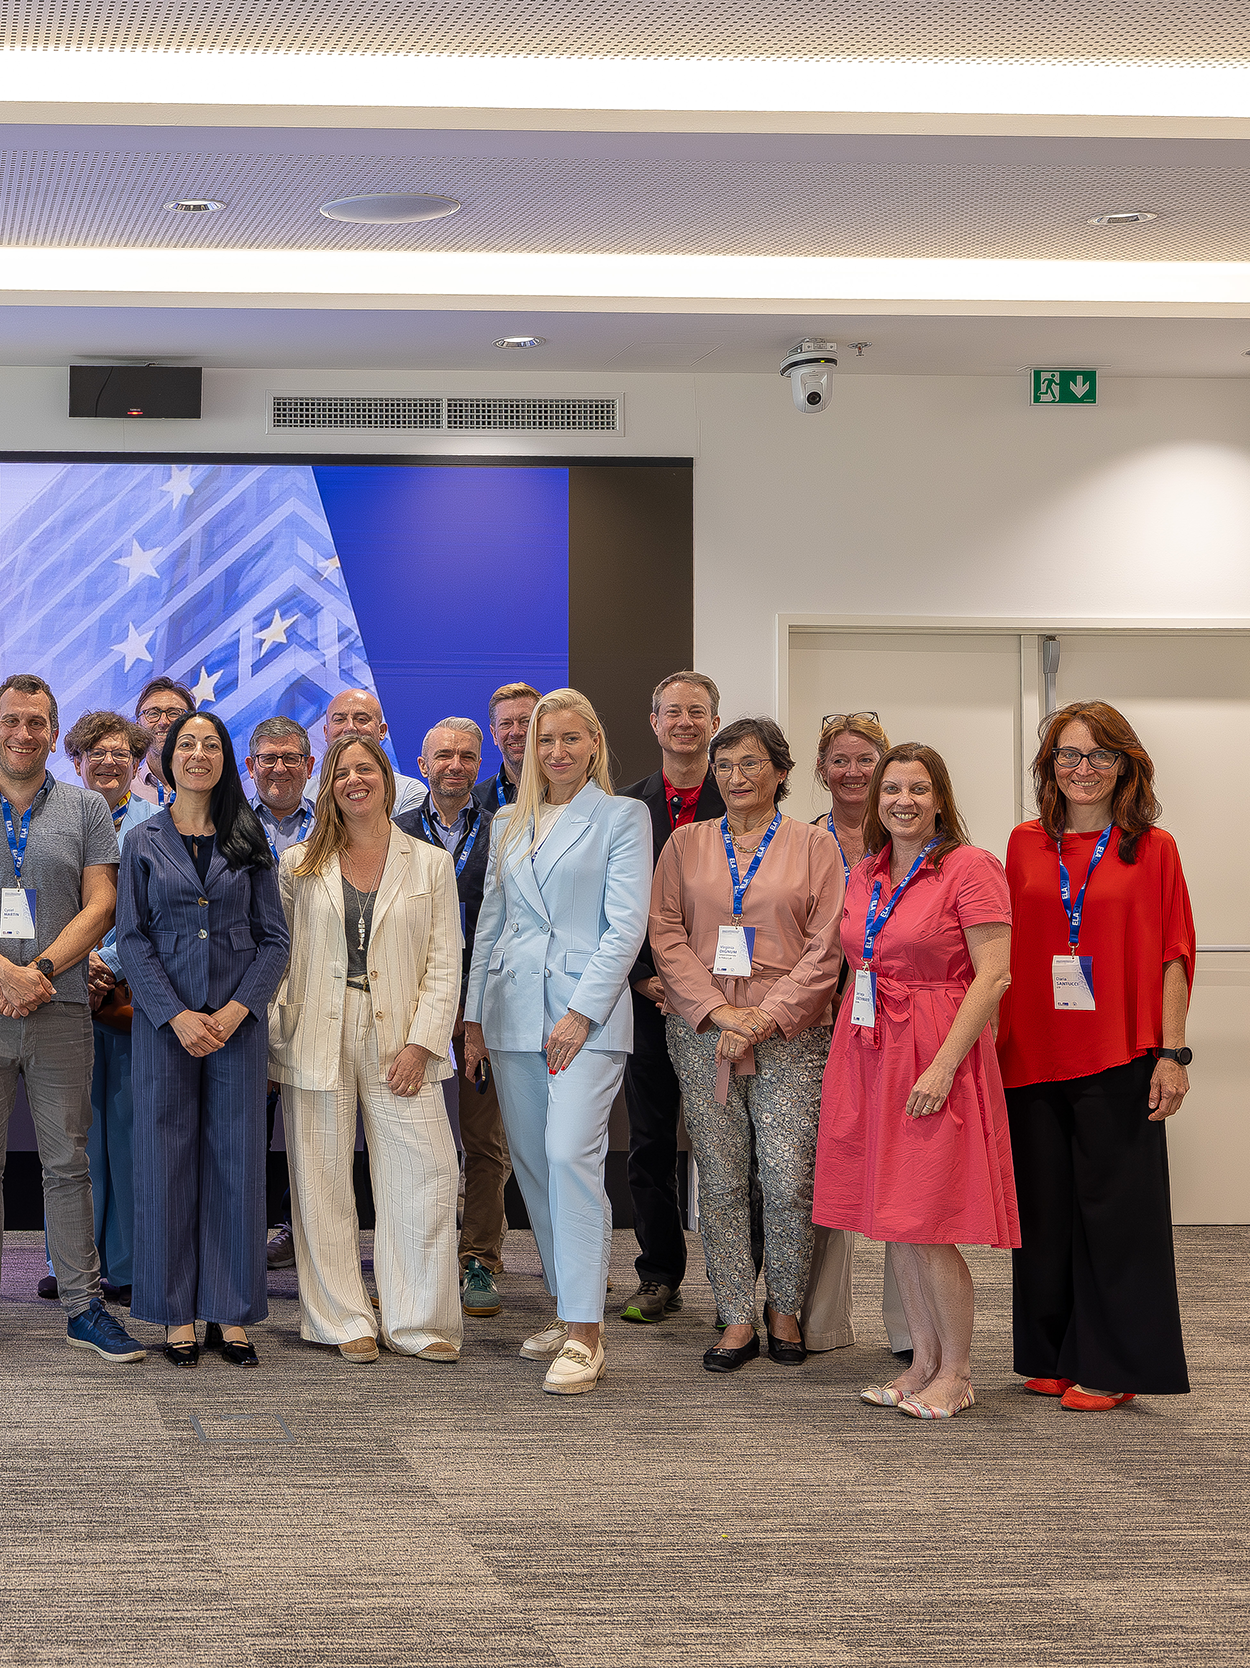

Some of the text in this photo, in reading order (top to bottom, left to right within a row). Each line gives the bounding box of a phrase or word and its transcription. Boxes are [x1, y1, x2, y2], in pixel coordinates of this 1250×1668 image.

[770, 821, 778, 831] ELA
[470, 828, 478, 838] ELA
[724, 833, 732, 844] ELA
[460, 851, 468, 861] ELA
[756, 846, 766, 858] ELA
[1095, 845, 1105, 858] ELA
[729, 858, 737, 869] ELA
[739, 878, 750, 889] ELA
[900, 876, 910, 887] ELA
[1061, 887, 1069, 900] ELA
[879, 906, 890, 918] ELA
[1072, 912, 1080, 926] ELA
[865, 936, 874, 949] ELA
